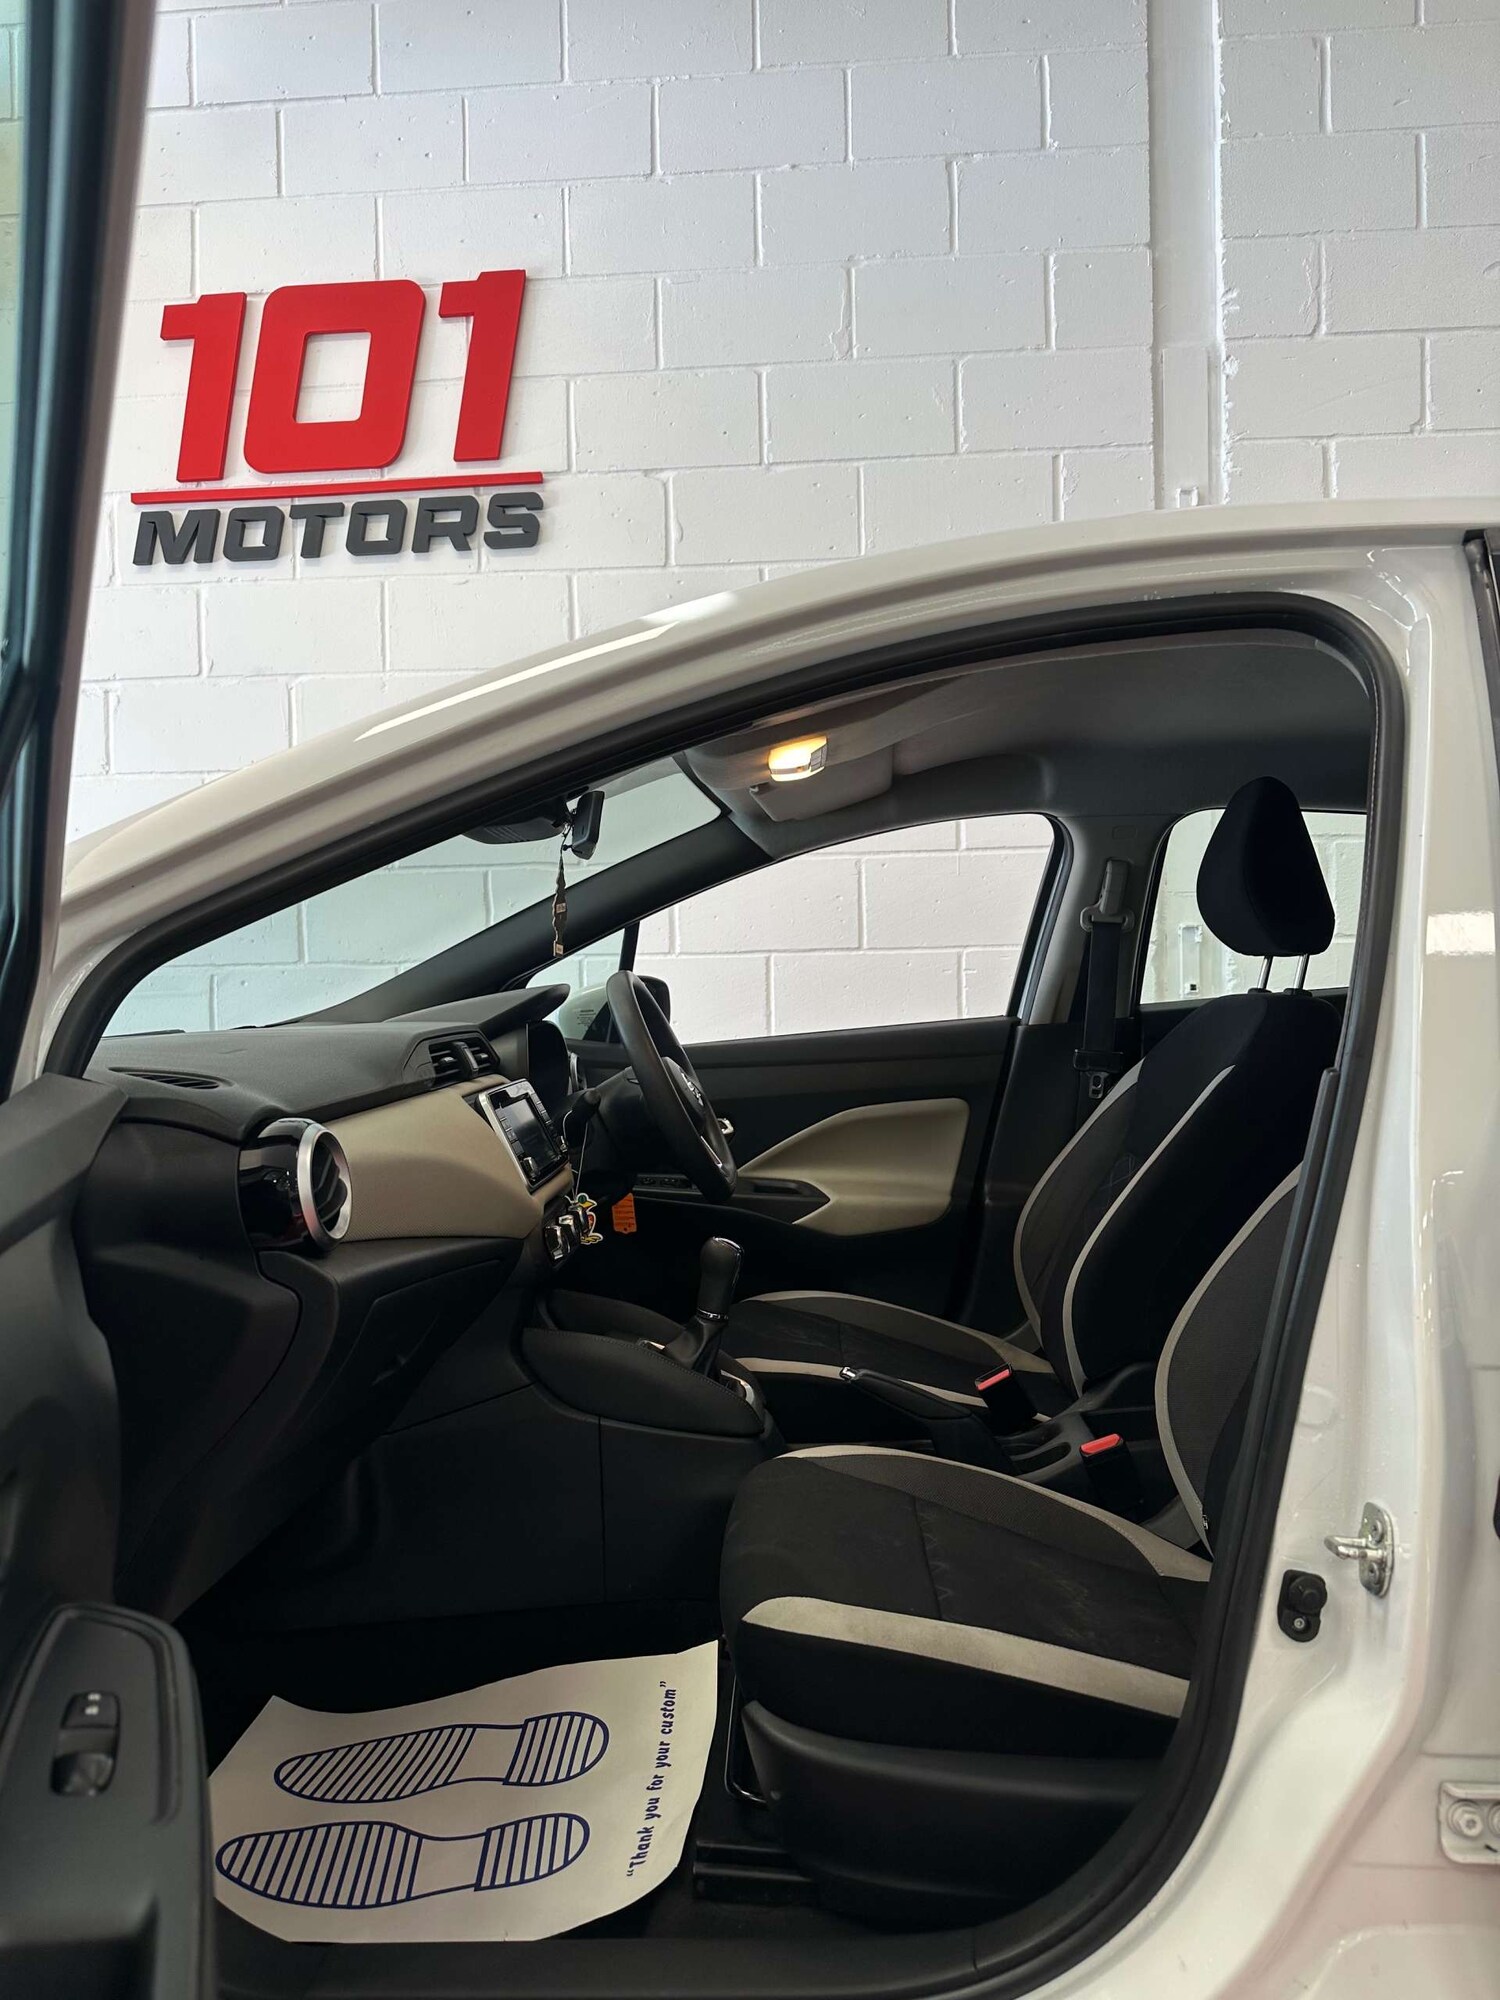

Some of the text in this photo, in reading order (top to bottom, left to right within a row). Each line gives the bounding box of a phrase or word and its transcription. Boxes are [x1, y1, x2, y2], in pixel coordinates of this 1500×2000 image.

[160, 269, 526, 482] 101
[132, 491, 544, 566] MOTORS
[655, 1740, 672, 1769] your
[646, 1774, 665, 1791] for
[644, 1797, 662, 1821] you
